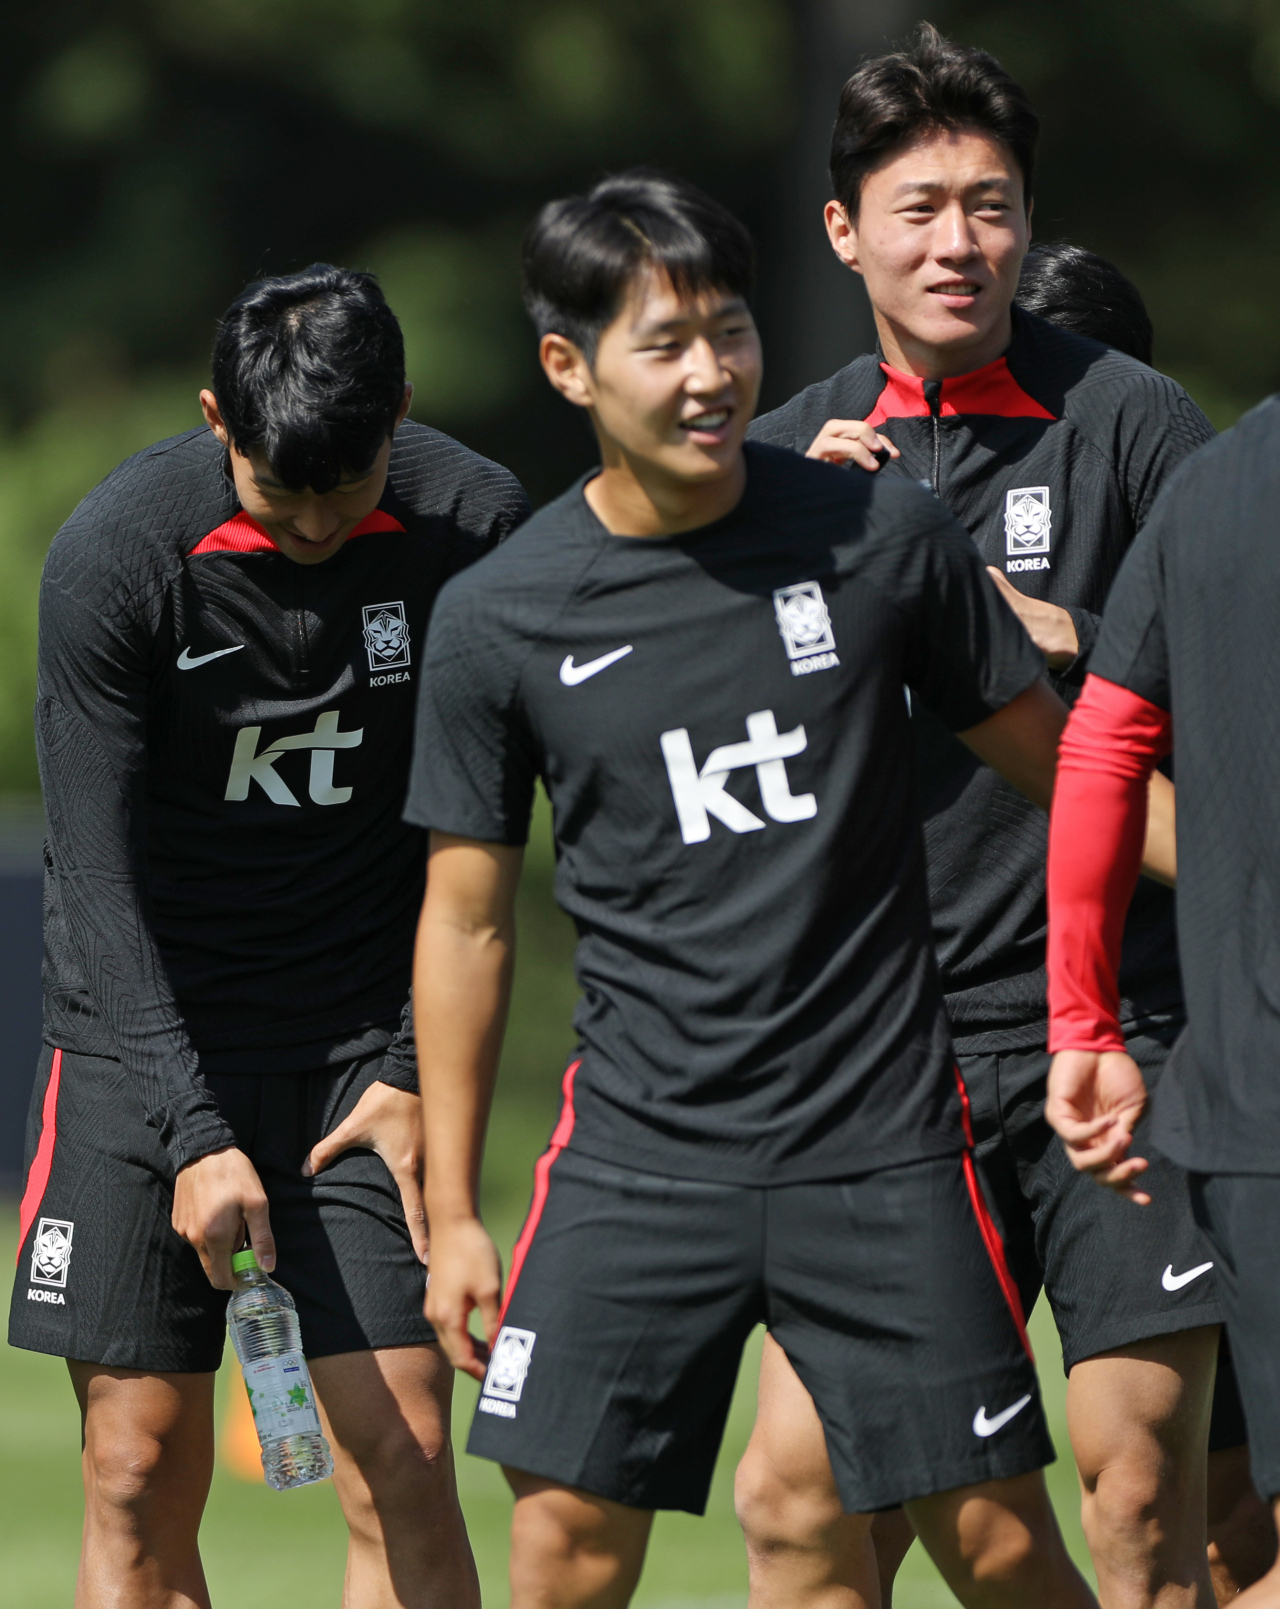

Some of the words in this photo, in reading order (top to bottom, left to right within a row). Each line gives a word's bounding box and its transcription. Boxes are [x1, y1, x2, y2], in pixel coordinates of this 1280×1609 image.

[1006, 556, 1051, 573] KOREA
[790, 652, 840, 676] KOREA
[369, 671, 411, 687] KOREA
[224, 710, 364, 807] kt
[660, 708, 818, 845] kt
[27, 1288, 66, 1305] KOREA
[479, 1396, 517, 1419] KOREA
